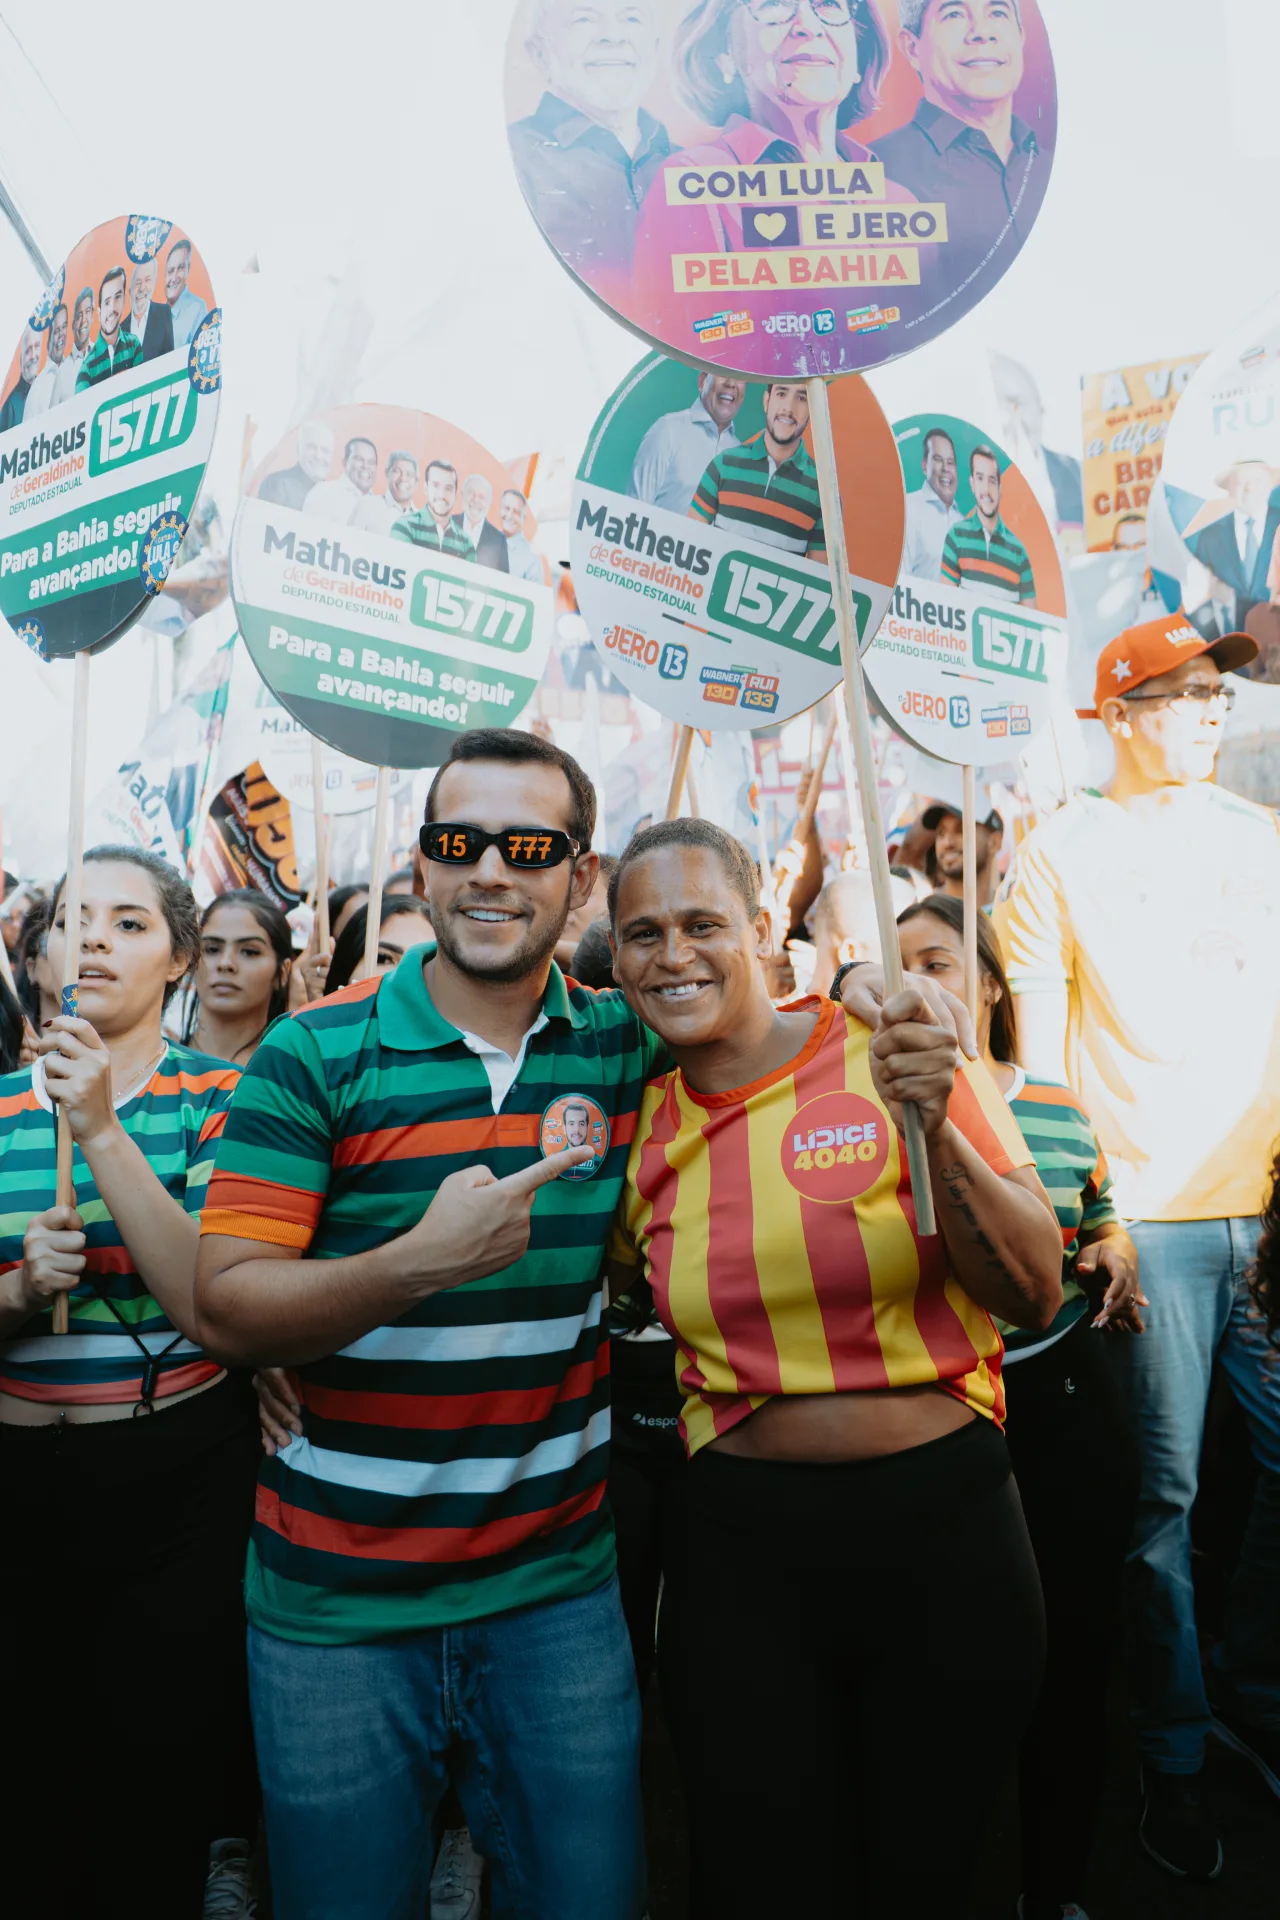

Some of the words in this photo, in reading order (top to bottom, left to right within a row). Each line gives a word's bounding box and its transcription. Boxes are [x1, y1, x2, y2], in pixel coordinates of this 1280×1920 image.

[678, 170, 767, 199] COM
[780, 168, 872, 196] LULA
[816, 213, 835, 239] E
[846, 210, 937, 239] JERO
[685, 258, 778, 287] PELA
[789, 252, 908, 284] BAHIA
[765, 314, 811, 334] JERO
[816, 313, 833, 331] 13
[848, 312, 884, 327] LULA
[886, 308, 897, 320] 13
[1102, 374, 1133, 412] A
[1143, 363, 1199, 400] VO
[97, 379, 193, 465] 15777
[0, 421, 86, 485] Matheus
[9, 491, 46, 516] DEPUTADO
[47, 476, 84, 502] ESTADUAL
[10, 481, 23, 501] de
[23, 454, 85, 495] Geraldinho
[1094, 486, 1150, 517] CAR
[1, 545, 39, 578] Para
[42, 541, 53, 561] a
[57, 518, 109, 558] Bahia
[113, 492, 182, 537] seguir
[147, 541, 171, 566] LULA
[576, 499, 712, 576] Matheus
[29, 541, 139, 601] avançando!
[263, 524, 407, 591] Matheus
[590, 543, 609, 564] de
[609, 548, 704, 599] Geraldinho
[282, 584, 344, 611] DEPUTADO
[345, 598, 402, 625] ESTADUAL
[283, 562, 305, 584] de
[306, 572, 405, 610] Geraldinho
[586, 564, 643, 594] DEPUTADO
[643, 583, 698, 616] ESTADUAL
[422, 575, 527, 646] 15777
[888, 585, 966, 631] theus
[604, 623, 660, 666] JERO
[663, 646, 687, 677] 13
[871, 639, 920, 657] DEPUTADO
[921, 649, 967, 667] ESTADUAL
[888, 619, 967, 652] Geraldinho
[978, 612, 1047, 672] 1577
[268, 625, 332, 663] Para
[338, 645, 355, 668] a
[361, 648, 434, 687] Bahia
[440, 672, 515, 708] seguir
[703, 668, 740, 684] WAGNER
[749, 675, 775, 691] RUI
[317, 672, 467, 725] avançando!
[706, 683, 735, 701] 130
[745, 689, 775, 708] 133
[901, 691, 947, 721] JERO
[952, 698, 969, 726] 13
[438, 833, 467, 857] 15
[508, 836, 553, 860] 777
[793, 1121, 877, 1152] LÍDICE
[794, 1141, 878, 1171] 4040
[647, 1416, 678, 1429] espo
